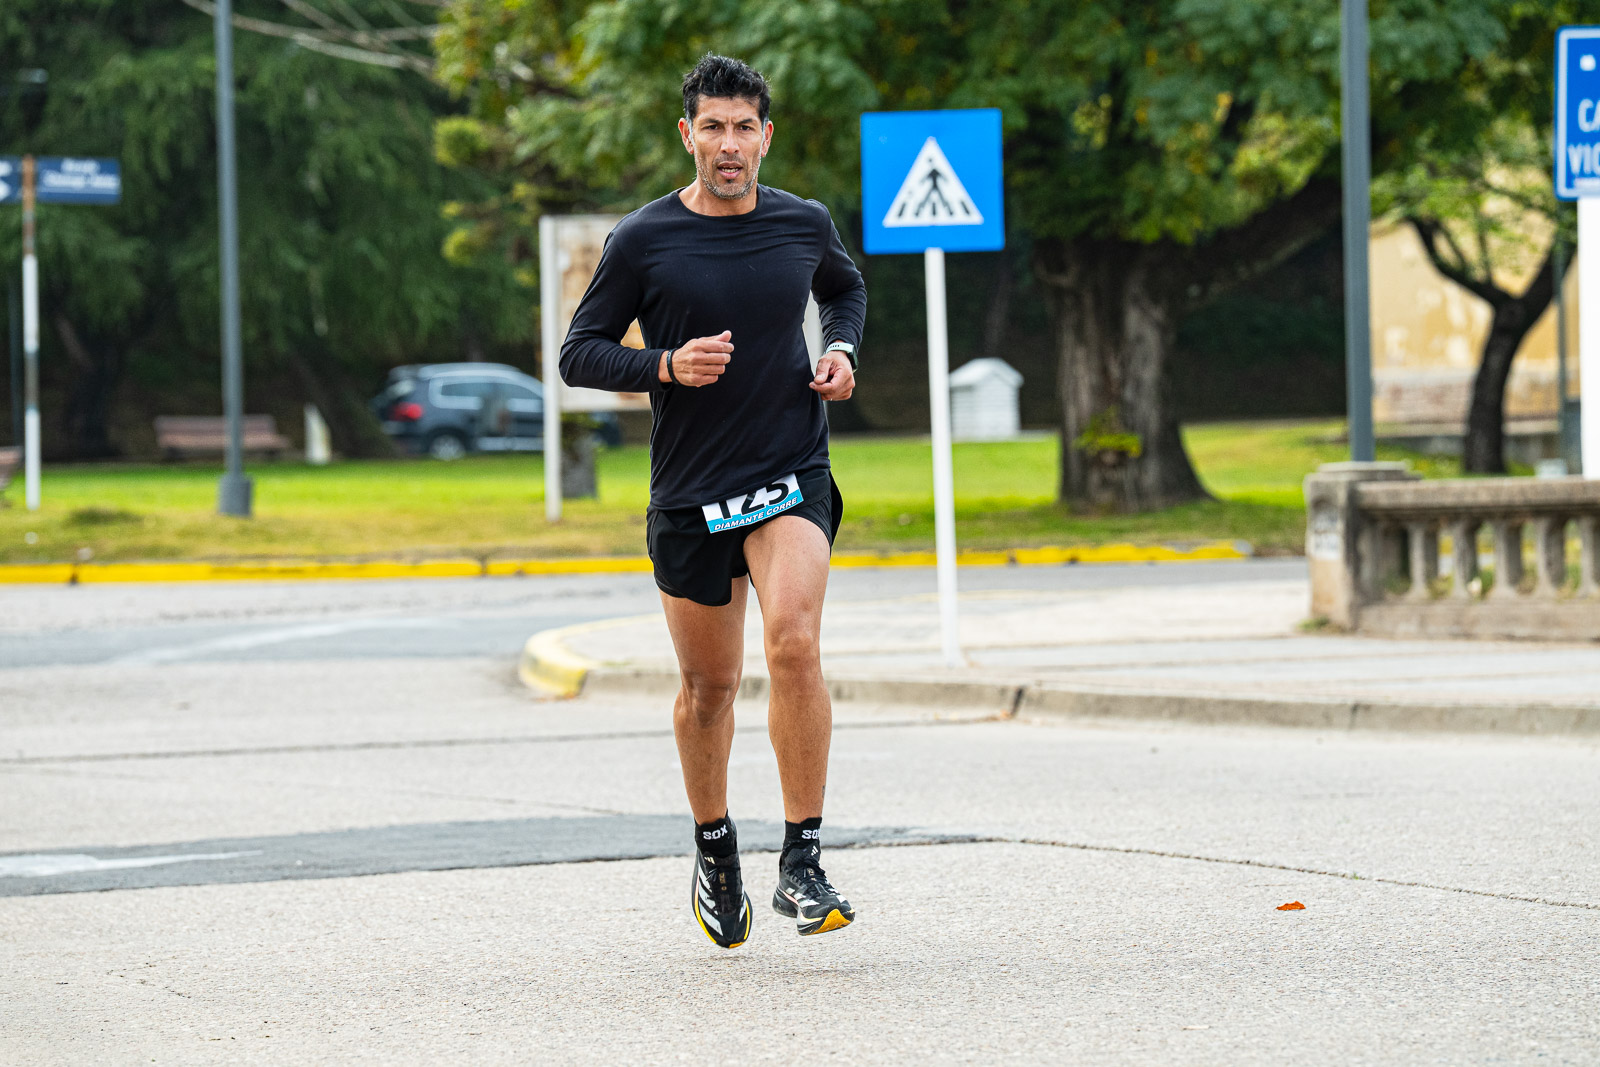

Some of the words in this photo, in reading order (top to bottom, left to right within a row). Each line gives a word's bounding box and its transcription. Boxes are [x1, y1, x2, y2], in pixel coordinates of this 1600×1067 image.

[714, 511, 765, 531] DIAMANTE
[766, 496, 798, 516] CORRE
[702, 824, 729, 840] SOX
[801, 829, 820, 840] SO
